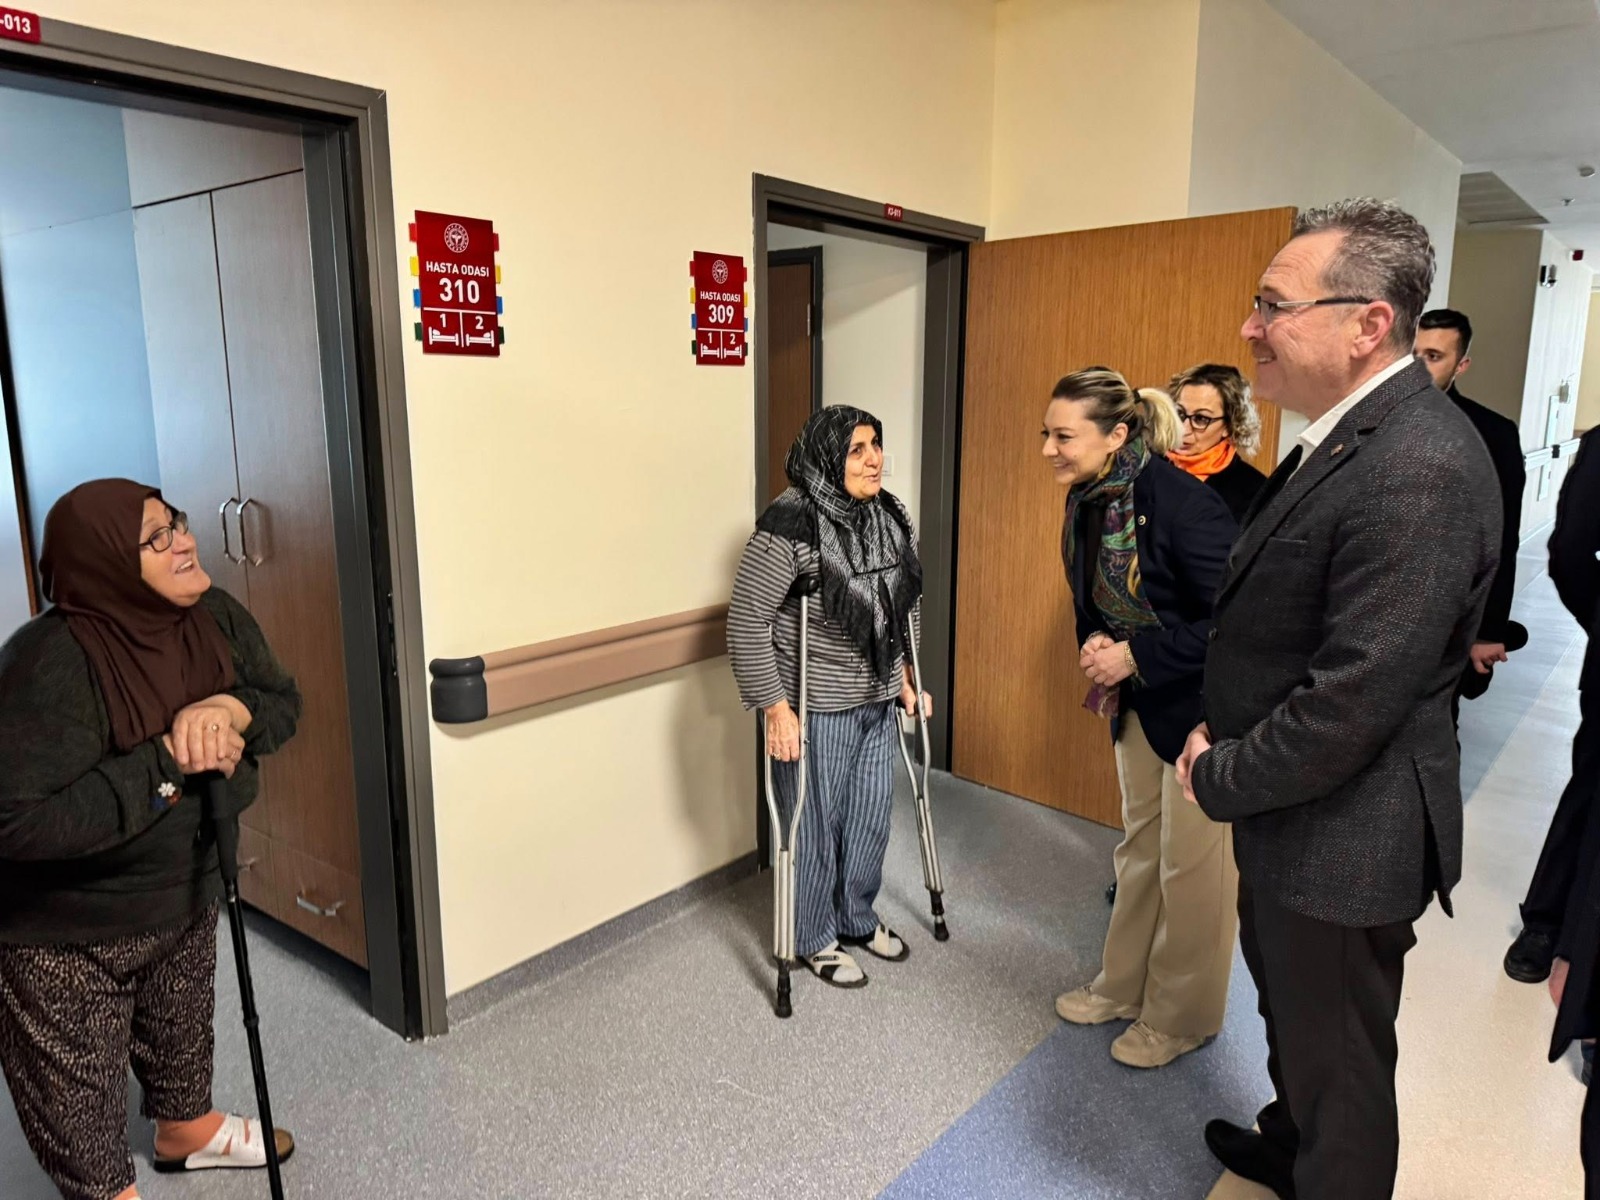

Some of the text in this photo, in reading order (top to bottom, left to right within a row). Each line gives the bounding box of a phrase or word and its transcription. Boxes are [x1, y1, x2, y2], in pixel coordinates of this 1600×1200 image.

[426, 261, 489, 277] HASTA ODASI
[439, 277, 480, 304] 310
[700, 291, 740, 302] HASTA ODASI
[440, 313, 484, 330] 1 2
[708, 304, 734, 324] 309
[708, 332, 736, 345] 1 2
